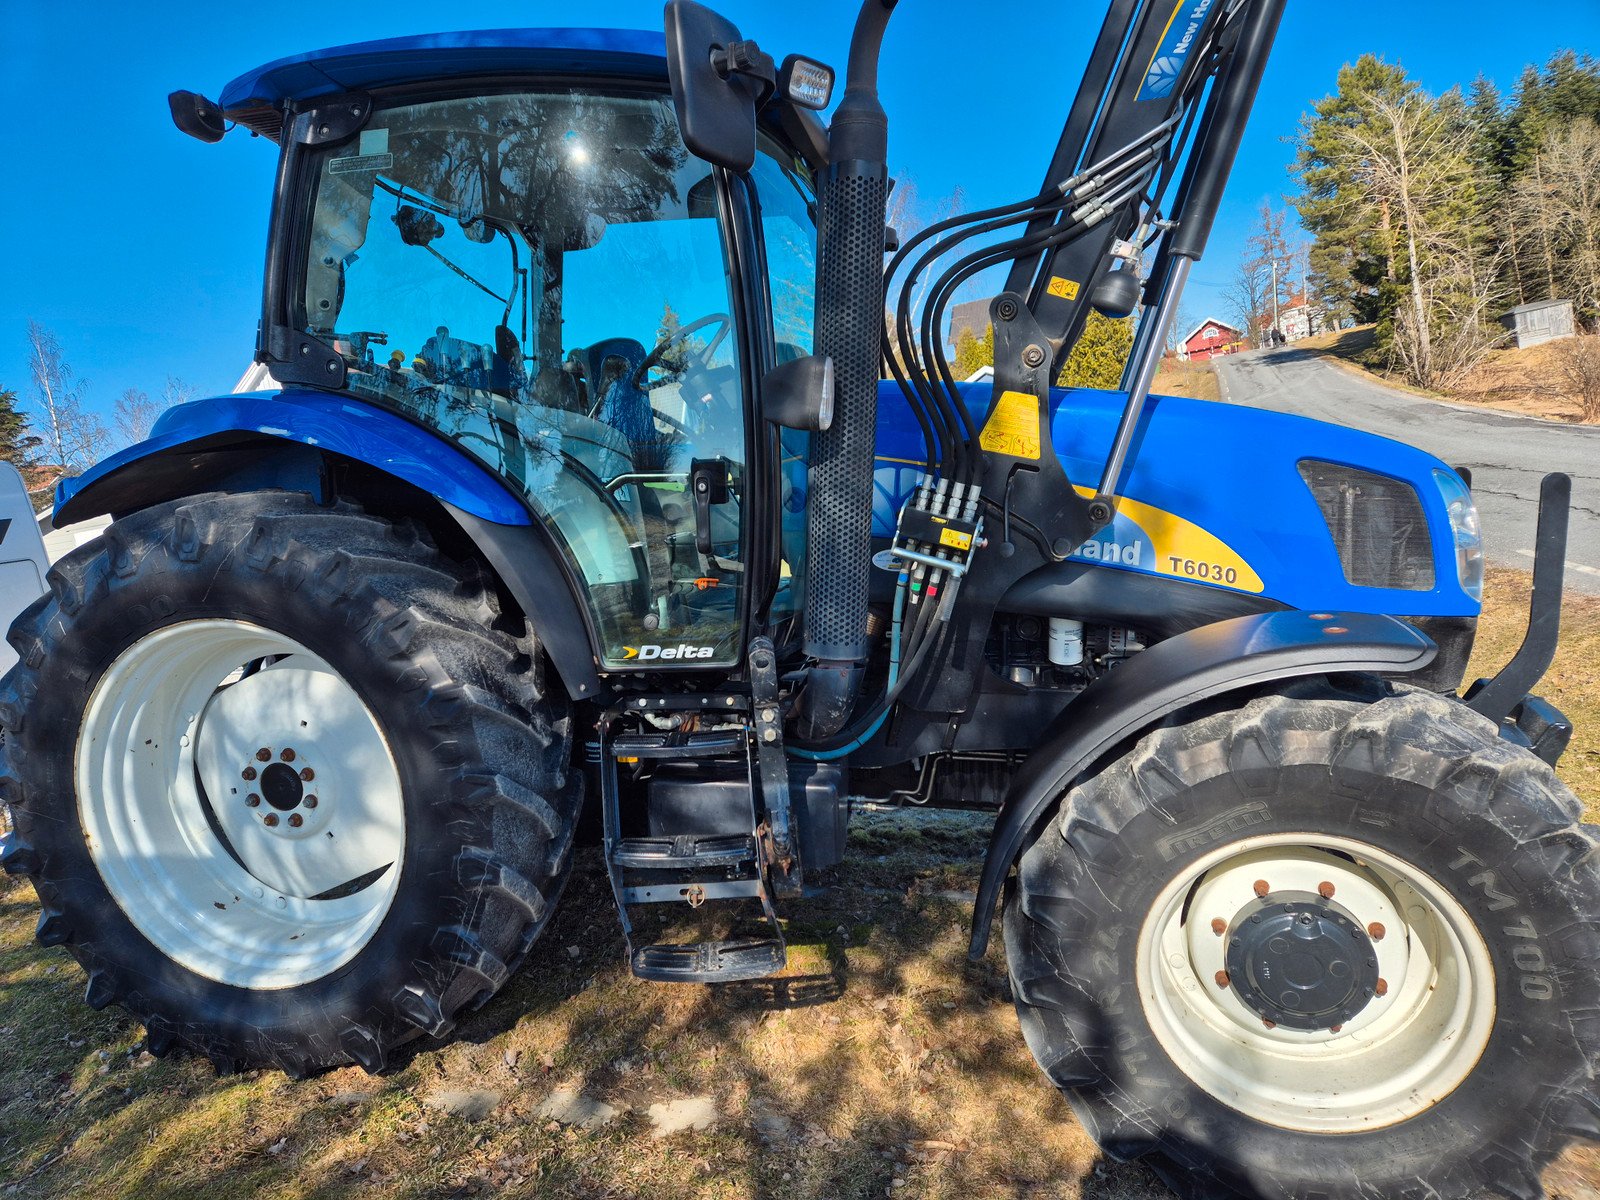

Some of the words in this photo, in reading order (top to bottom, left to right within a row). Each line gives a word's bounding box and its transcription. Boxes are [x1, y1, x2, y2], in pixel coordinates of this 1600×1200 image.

[1173, 21, 1199, 54] New
[1073, 539, 1142, 566] and
[1168, 555, 1238, 585] T6030
[638, 643, 715, 661] Delta
[1448, 845, 1519, 912] TM
